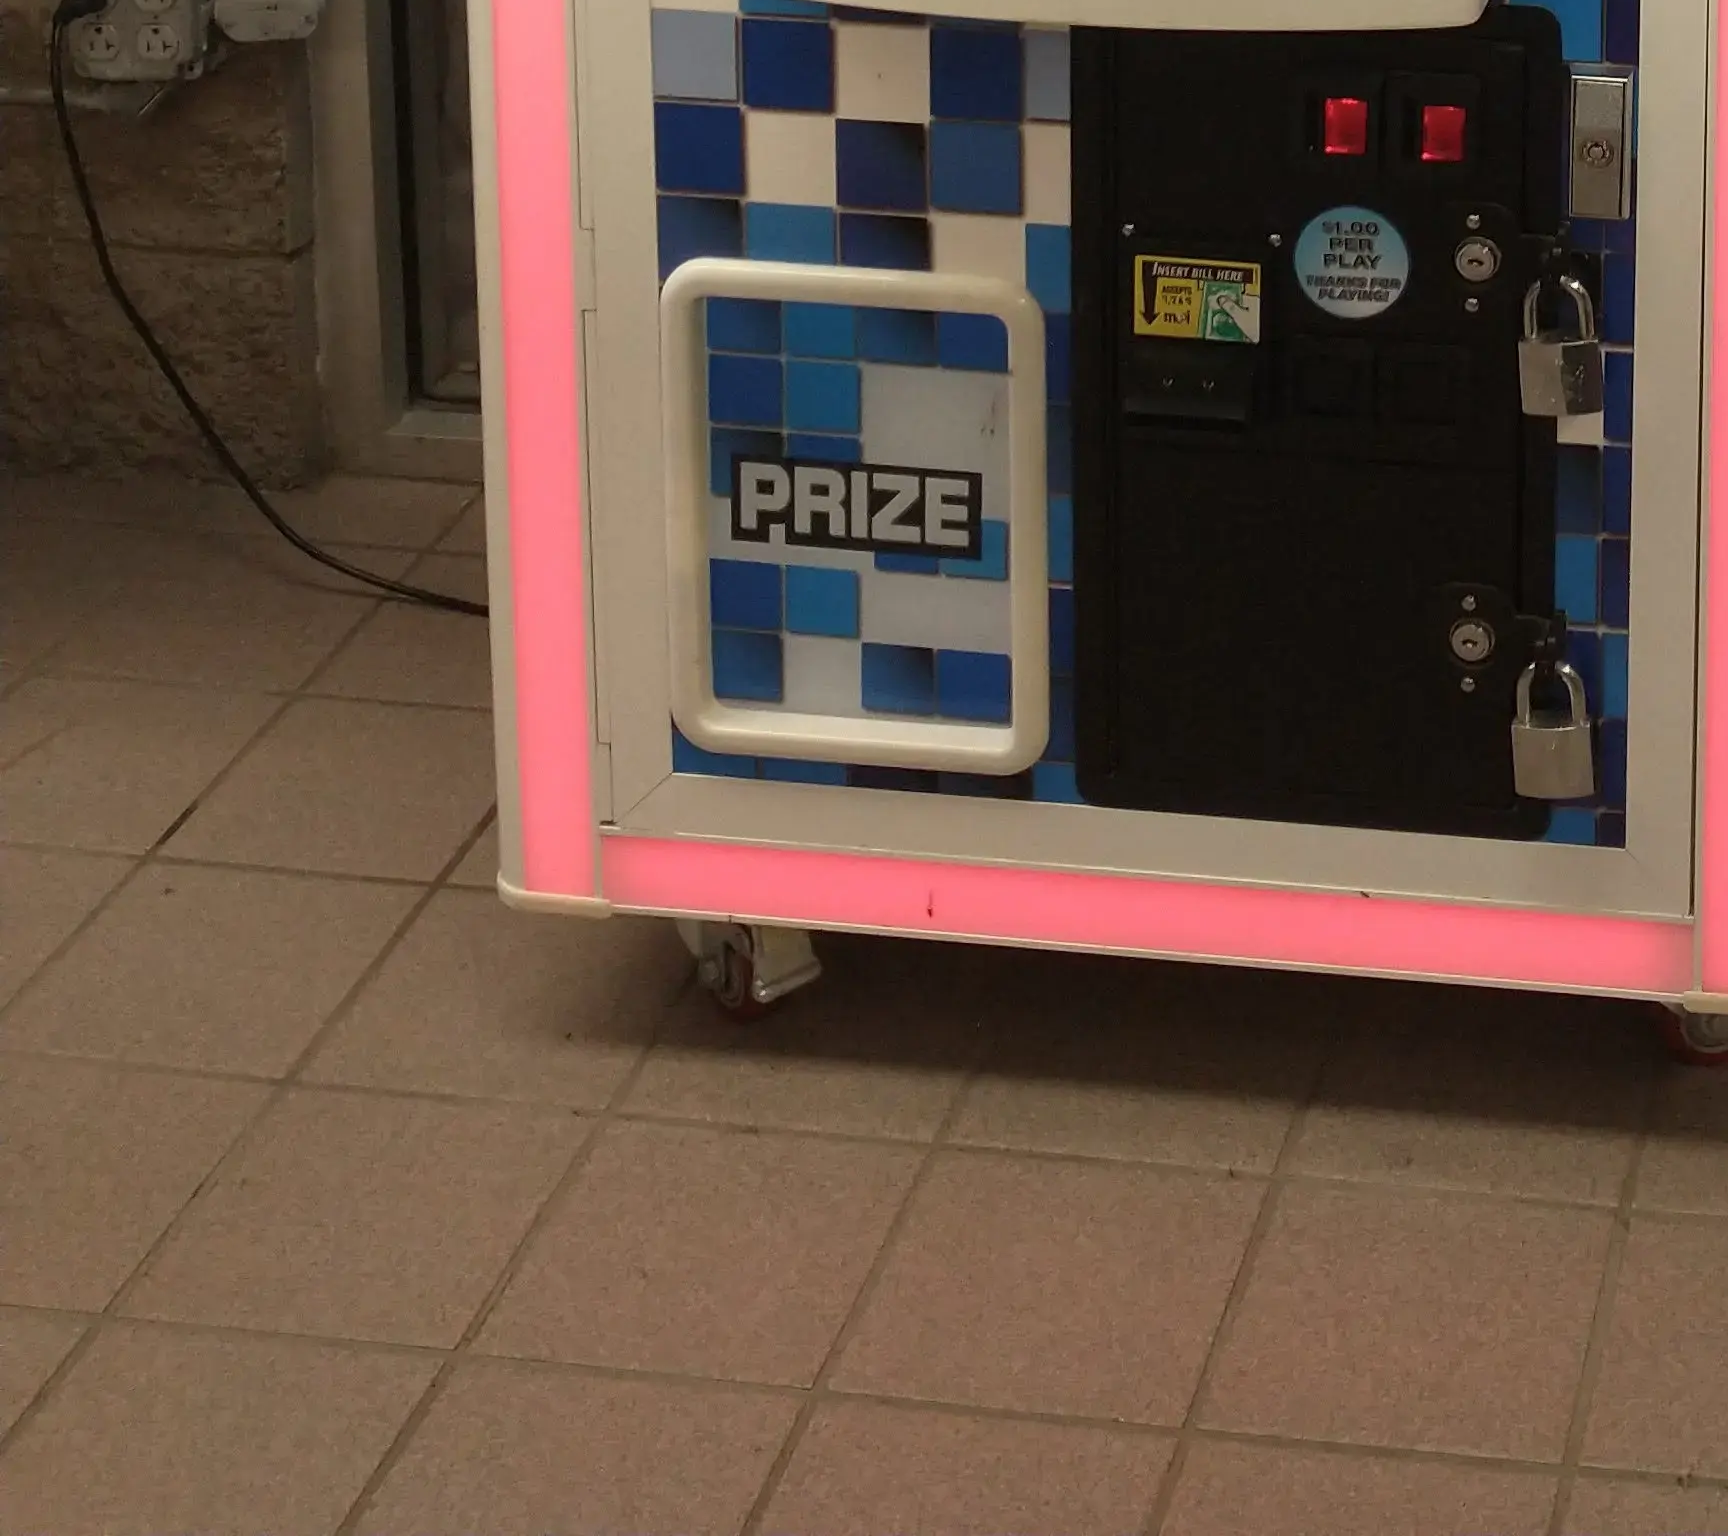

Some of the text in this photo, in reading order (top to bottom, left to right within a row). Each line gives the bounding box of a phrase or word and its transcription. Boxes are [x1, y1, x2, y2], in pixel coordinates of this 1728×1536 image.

[1329, 237, 1374, 253] PER
[1323, 253, 1382, 269] PLAY
[1152, 262, 1244, 281] INSERT BILL HERE
[739, 461, 970, 548] PRIZE
